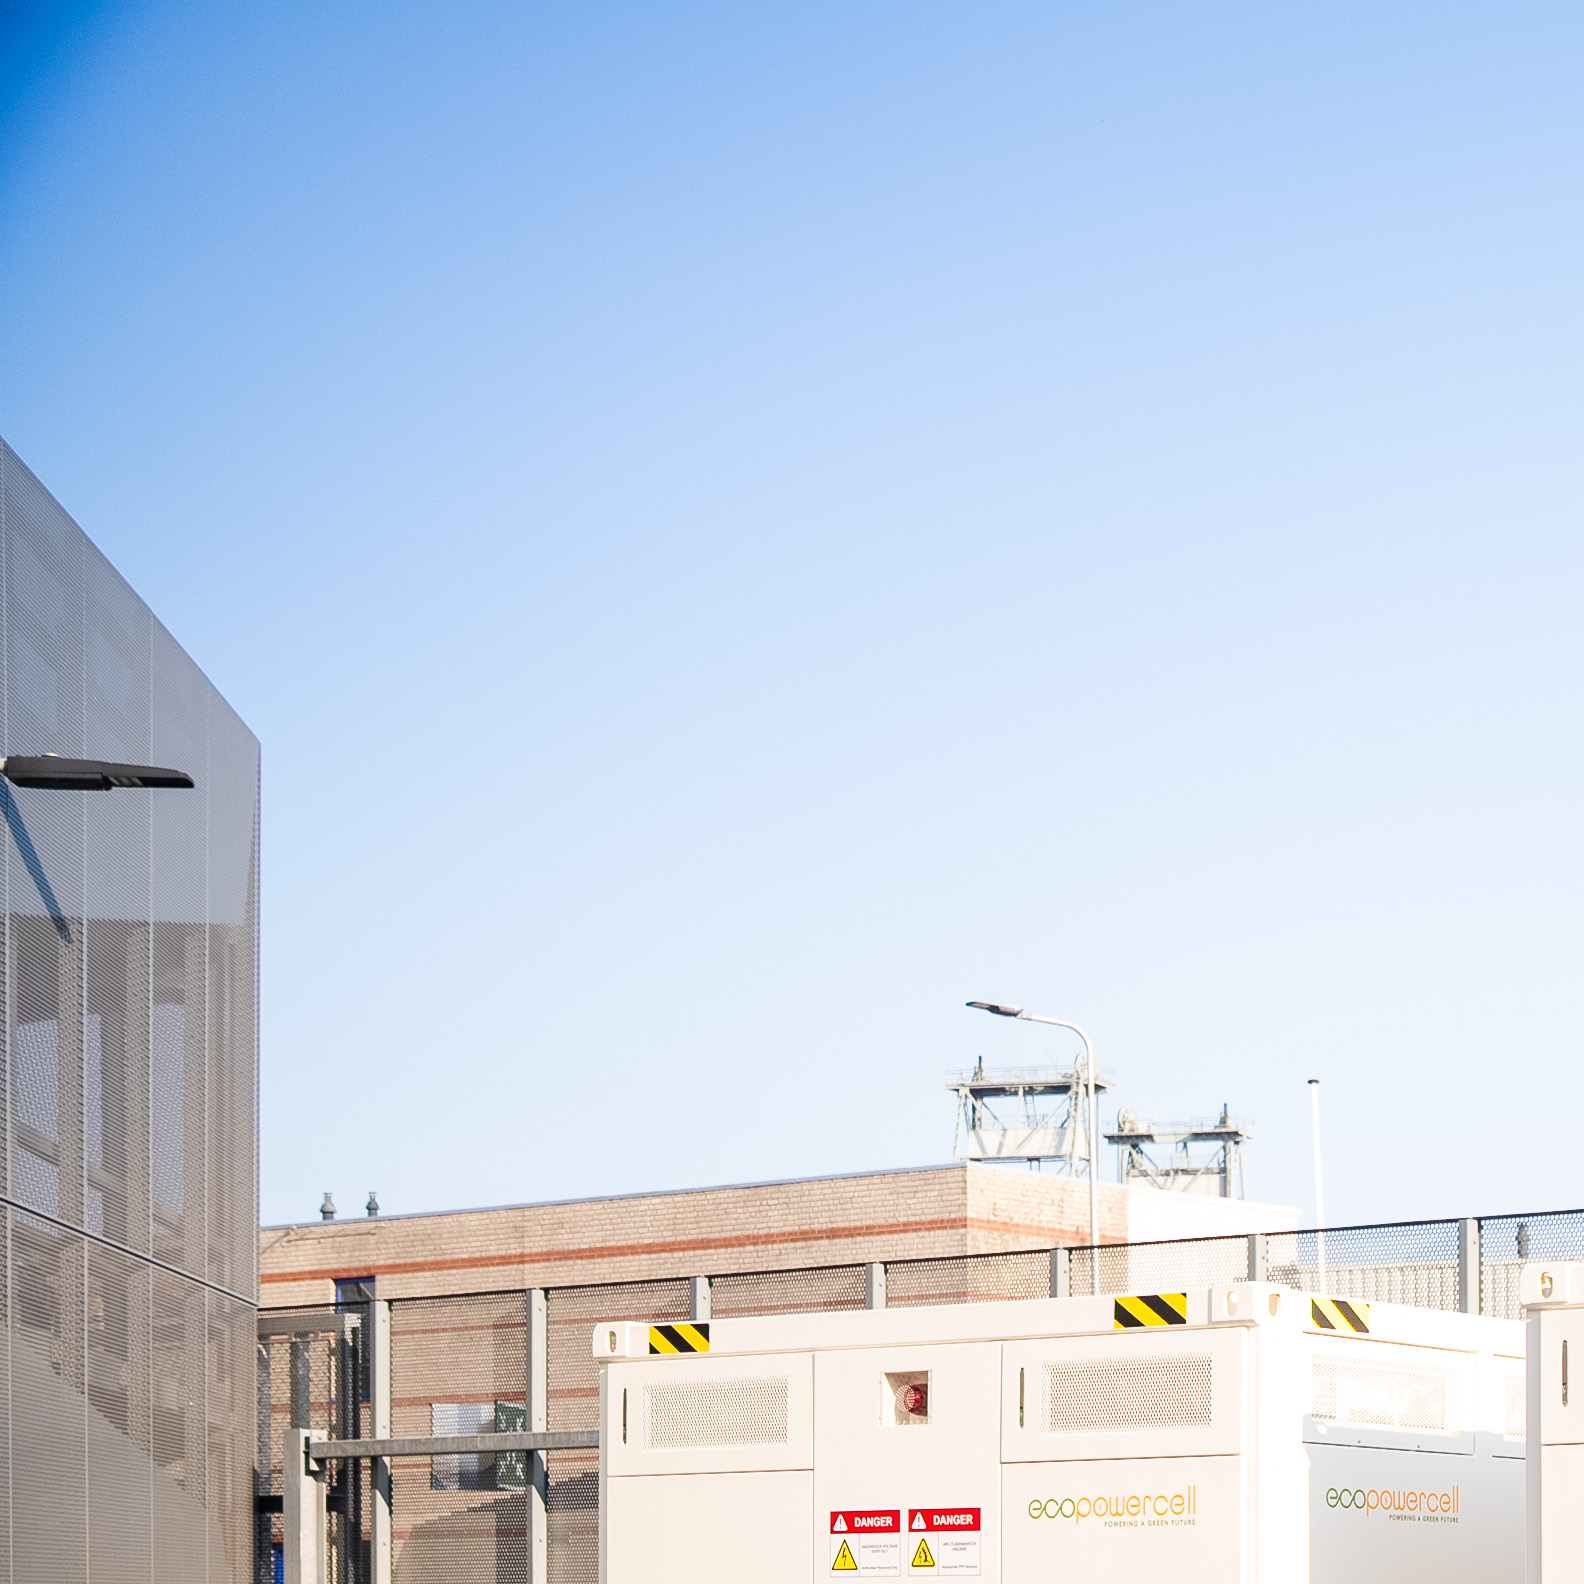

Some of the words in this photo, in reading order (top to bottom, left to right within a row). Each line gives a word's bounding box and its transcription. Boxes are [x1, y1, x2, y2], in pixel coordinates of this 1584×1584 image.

[1028, 1485, 1196, 1525] ecopowercell
[1325, 1485, 1459, 1517] ecopowercell
[854, 1516, 893, 1528] DANGER
[933, 1514, 973, 1526] DANGER
[1389, 1514, 1416, 1522] POWERING
[1422, 1515, 1439, 1523] GREEN
[1440, 1516, 1459, 1524] FUTURE
